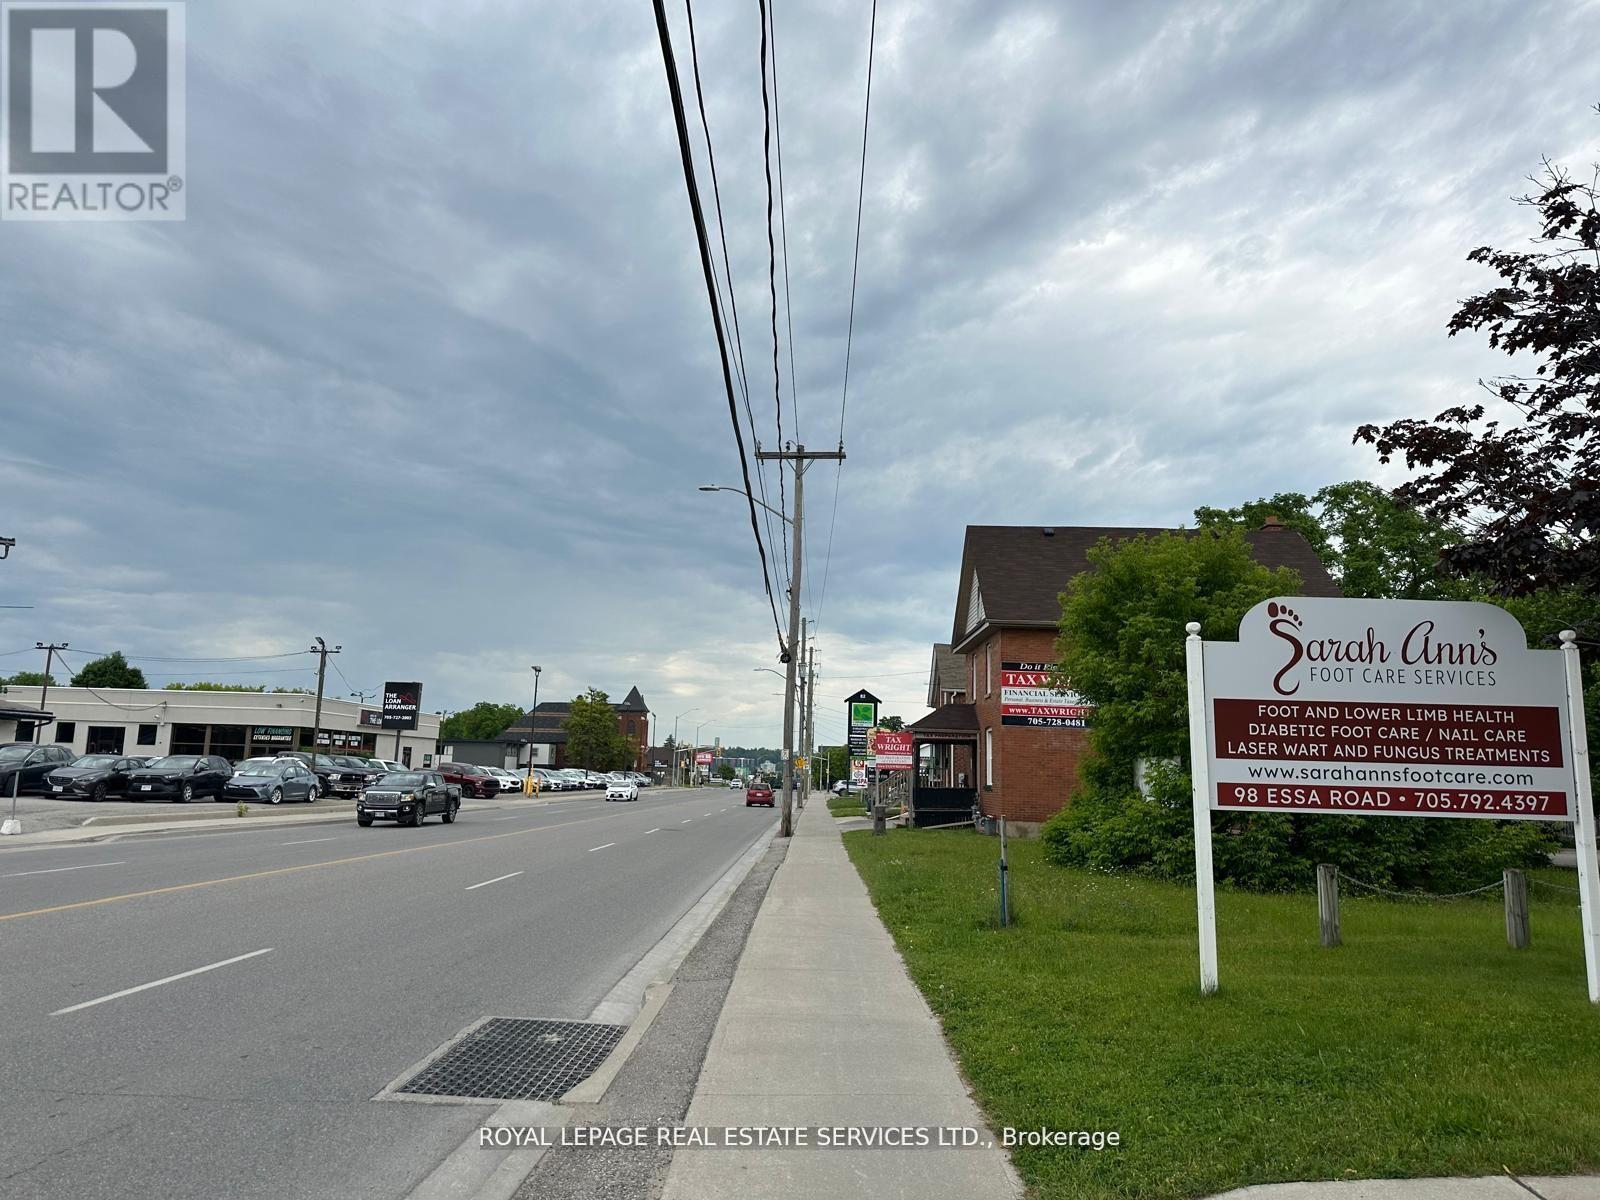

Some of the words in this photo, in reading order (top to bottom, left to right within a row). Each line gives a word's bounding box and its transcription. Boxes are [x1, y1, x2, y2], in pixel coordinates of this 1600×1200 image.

[1268, 618, 1391, 696] Sarah
[1401, 620, 1498, 666] Ann's
[1006, 673, 1037, 686] TAX
[1309, 666, 1355, 683] FOOT
[1362, 667, 1406, 685] CARE
[1414, 669, 1497, 687] SERVICES
[1004, 689, 1049, 697] FINANCIAL
[1027, 717, 1086, 727] 705-728-0481
[1257, 704, 1300, 718] FOOT
[1304, 706, 1340, 719] AND
[1344, 707, 1402, 721] LOWER
[1406, 708, 1448, 722] LIMB
[1452, 709, 1515, 724] HEALTH
[885, 736, 902, 744] TAX
[1248, 723, 1327, 738] DIABETIC
[1330, 725, 1373, 739] FOOT
[1377, 726, 1420, 740] CARE
[1425, 728, 1433, 743] /
[1438, 728, 1479, 742] NAIL
[1483, 730, 1527, 743] CARE
[877, 743, 911, 752] WRIGHT
[1227, 741, 1278, 755] LASER
[1282, 742, 1328, 757] WART
[1333, 744, 1368, 758] AND
[1373, 745, 1440, 760] FUNGUS
[1445, 747, 1550, 763] TREATMENTS
[1247, 765, 1534, 786] www.sarahannsfootcare.com
[1233, 786, 1259, 804] 98
[1267, 788, 1322, 805] ESSA
[1329, 789, 1391, 807] ROAD
[1414, 791, 1550, 812] 705.792.4397
